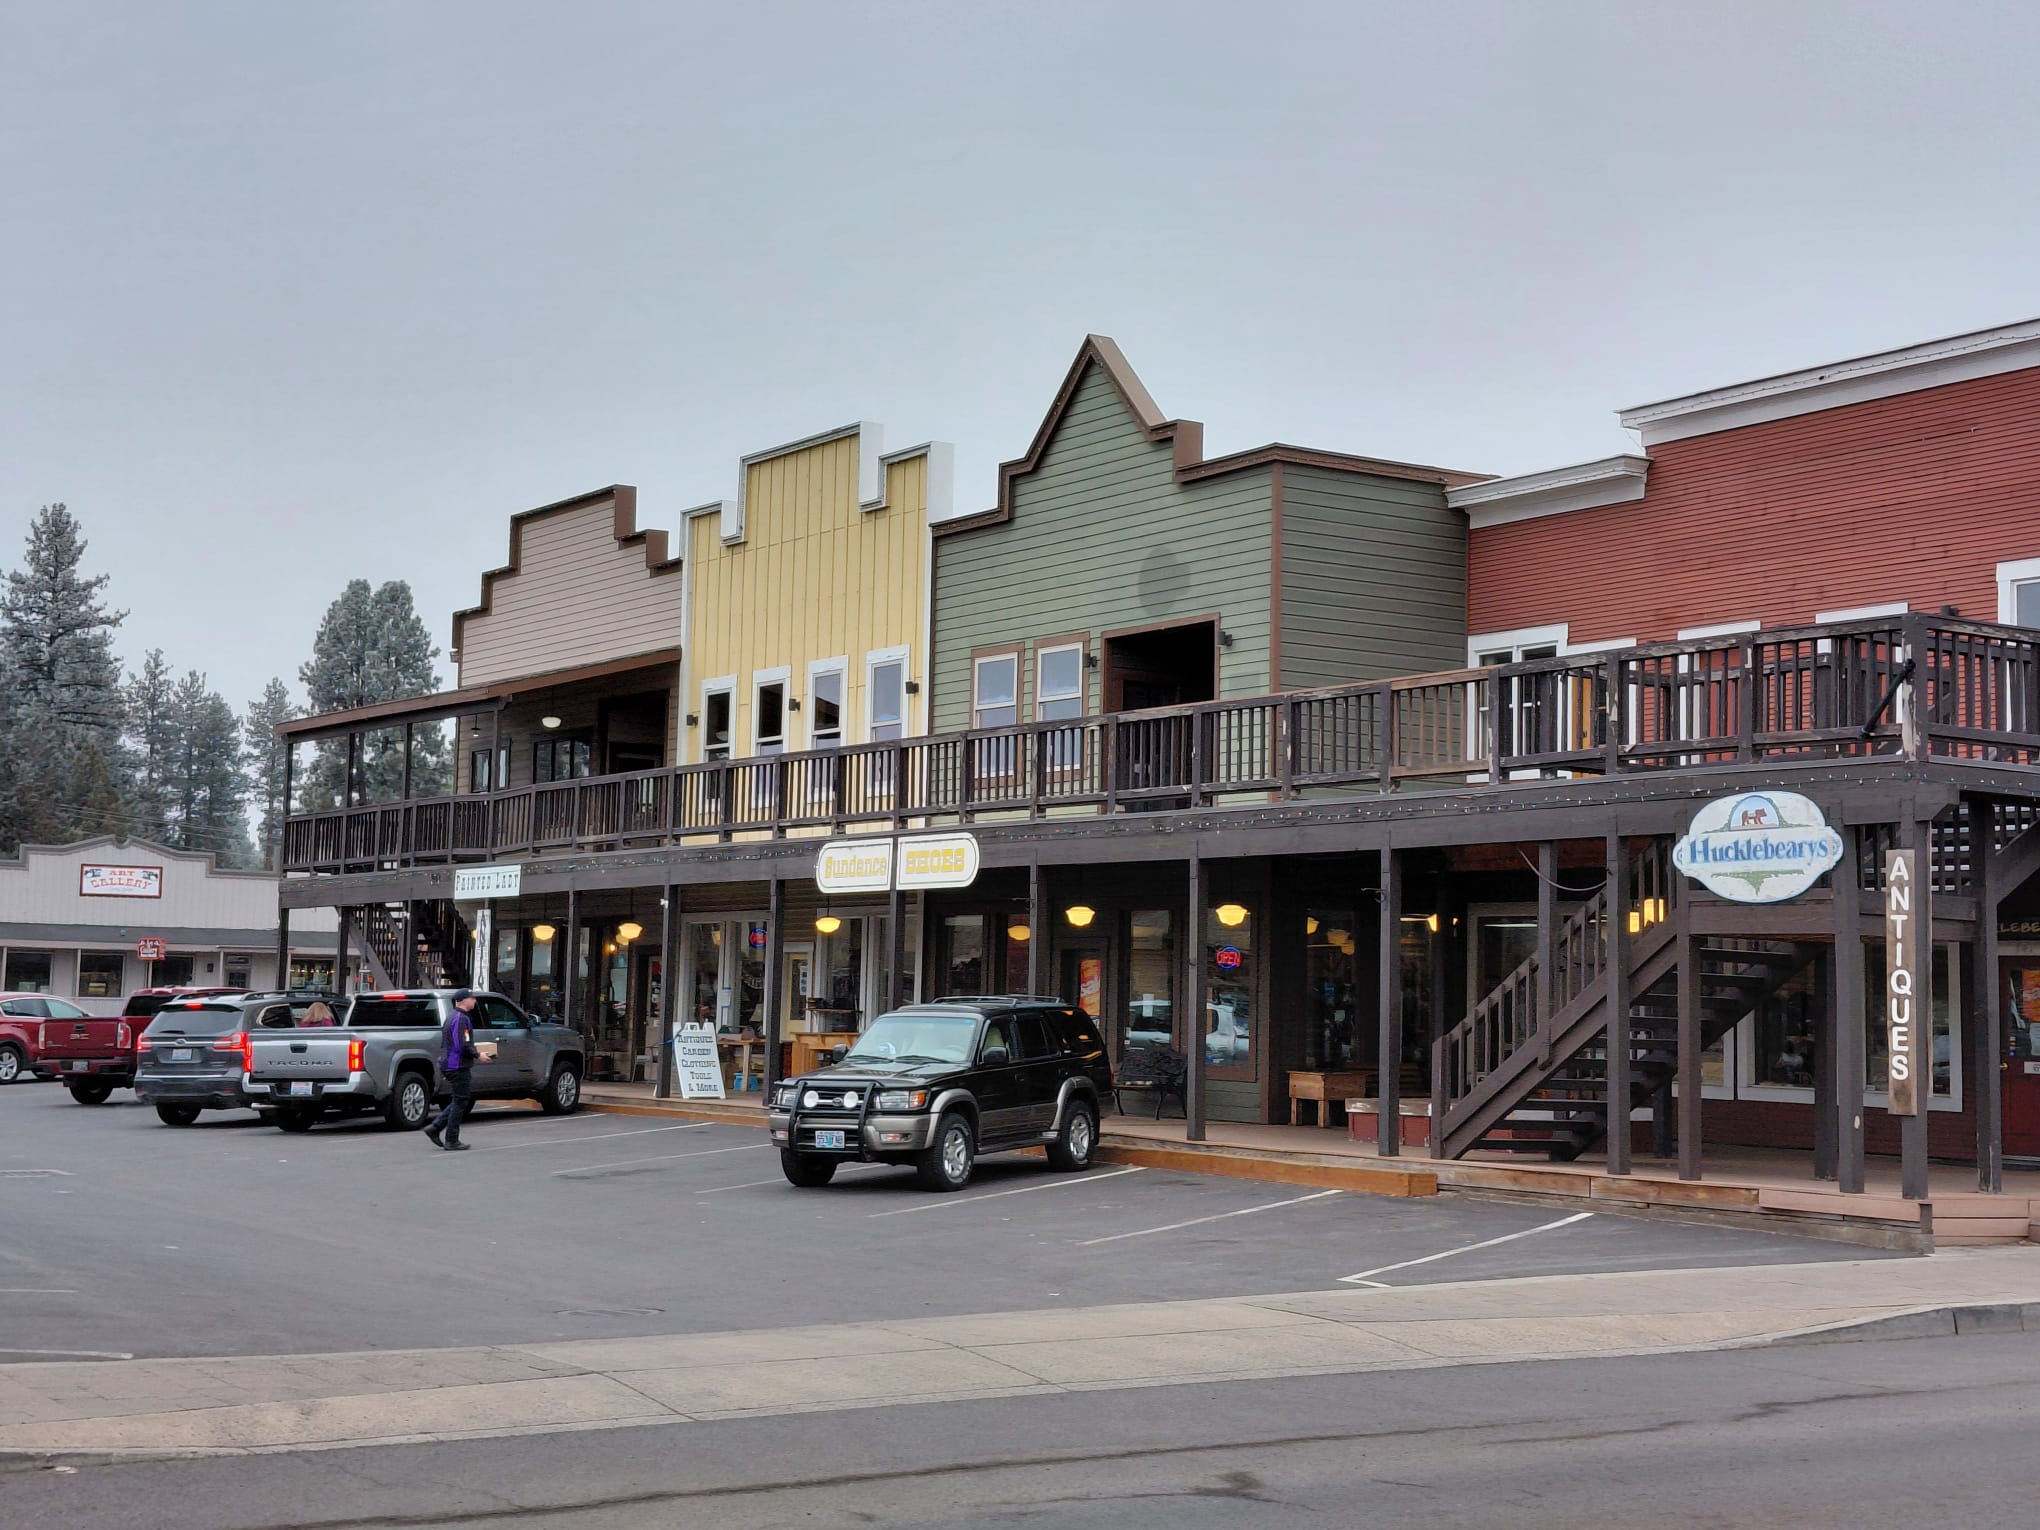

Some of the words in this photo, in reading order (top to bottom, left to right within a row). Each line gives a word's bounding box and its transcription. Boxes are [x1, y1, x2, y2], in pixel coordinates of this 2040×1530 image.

[824, 855, 887, 878] Sundance
[906, 848, 966, 874] SHOES
[1689, 836, 1829, 866] Hucklebearys
[90, 877, 152, 890] GALLERY
[1889, 856, 1912, 1081] ANTIQUES
